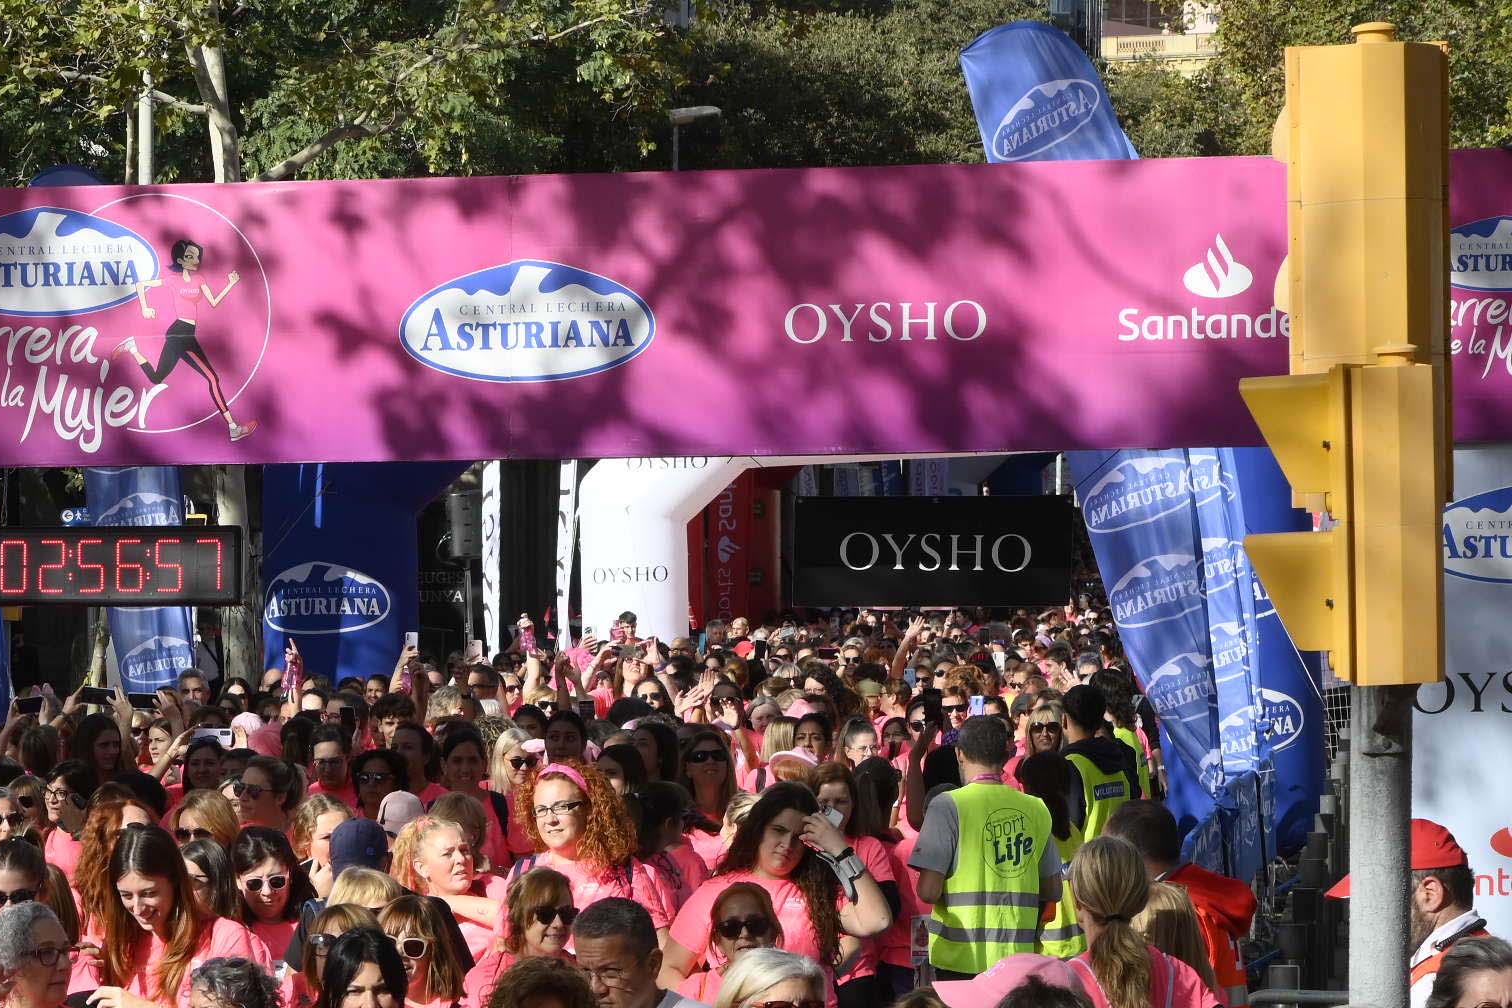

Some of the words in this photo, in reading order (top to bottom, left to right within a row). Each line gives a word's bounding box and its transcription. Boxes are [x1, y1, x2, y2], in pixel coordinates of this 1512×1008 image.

[60, 244, 135, 256] LECHERA
[1449, 254, 1512, 273] STUR
[459, 303, 537, 315] CENTRAL
[545, 301, 626, 313] LECHERA
[784, 300, 986, 344] OYSHO
[421, 307, 635, 353] ASTURIANA
[1118, 307, 1291, 342] Santande
[1468, 328, 1486, 355] la
[0, 367, 25, 408] la
[20, 360, 168, 453] Mujer
[0, 538, 223, 594] 02:56:57
[838, 531, 1032, 573] OYSHO
[593, 565, 669, 585] OYSHO
[268, 592, 381, 619] ASTURIANA
[986, 814, 1026, 842] Sport
[992, 832, 1034, 867] Life
